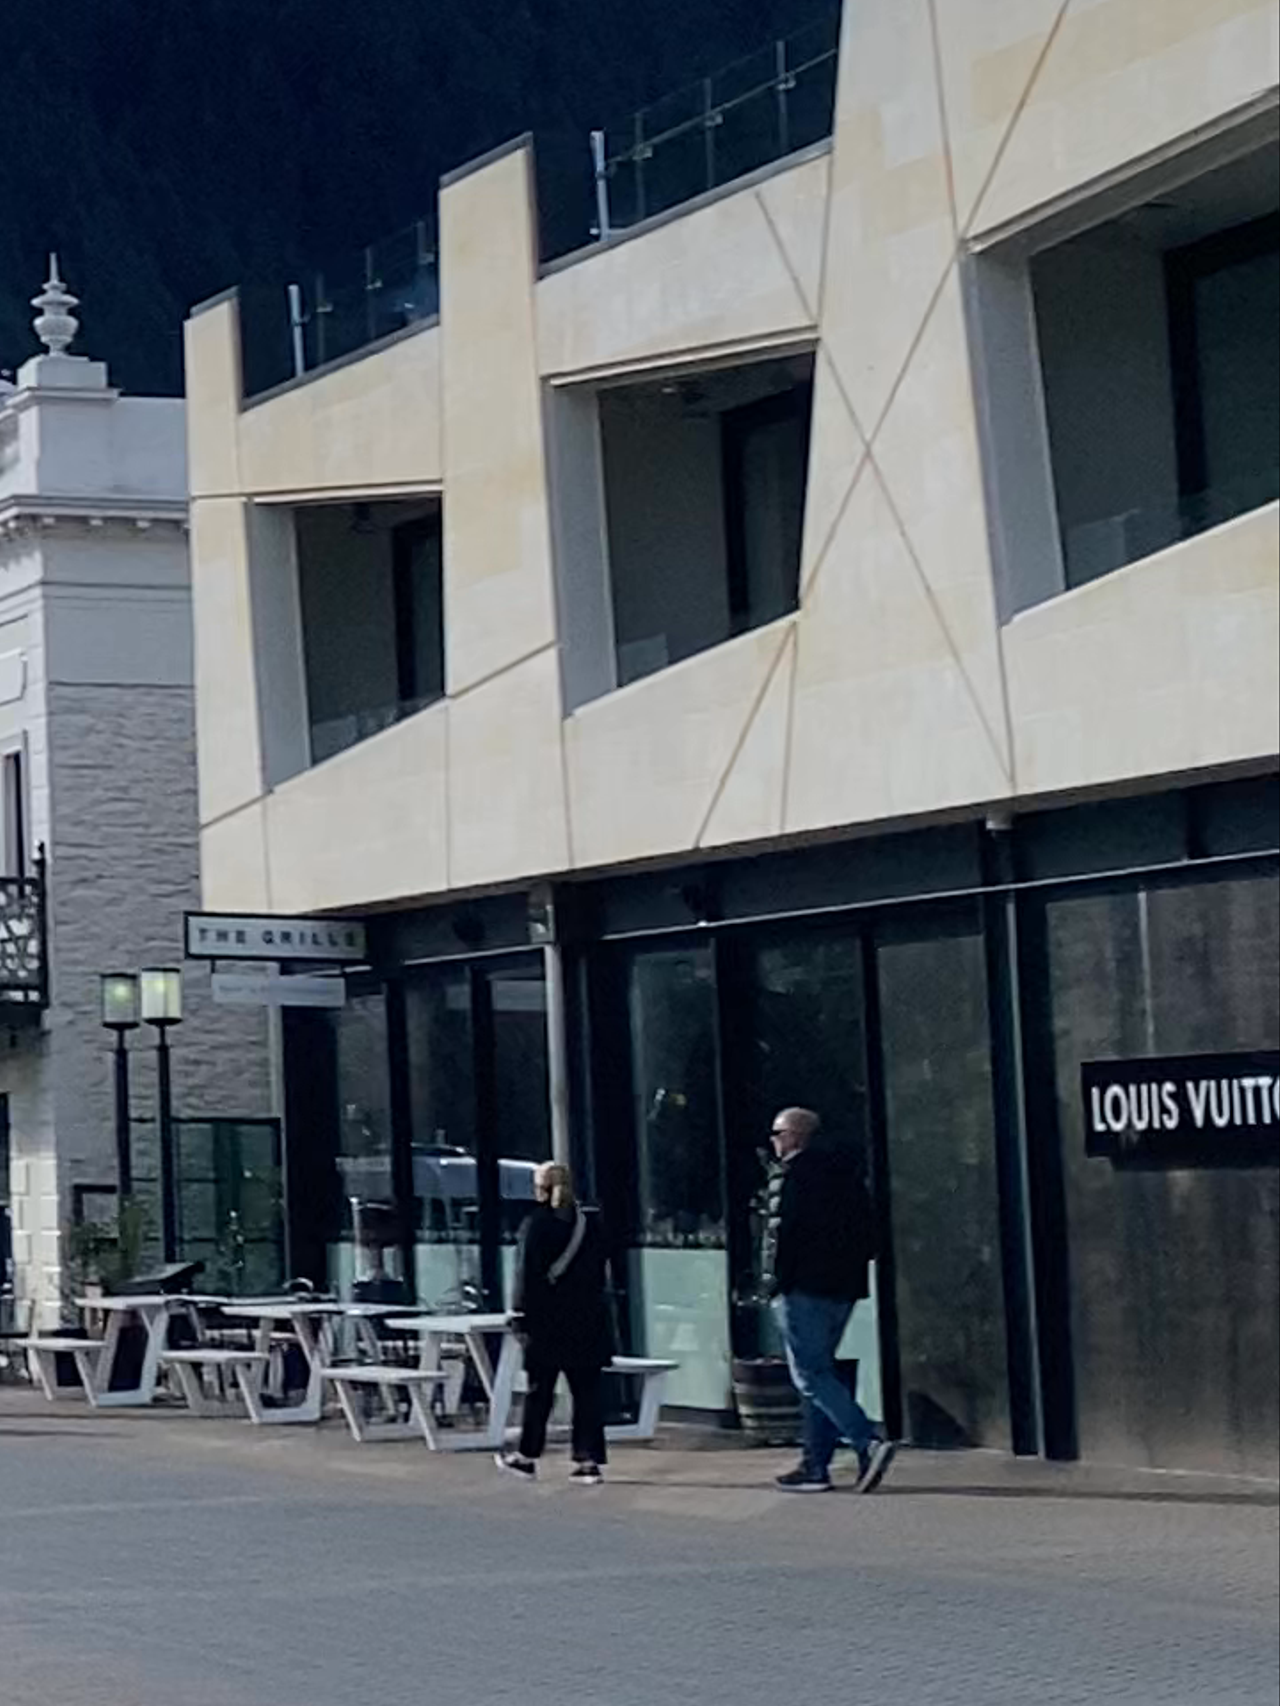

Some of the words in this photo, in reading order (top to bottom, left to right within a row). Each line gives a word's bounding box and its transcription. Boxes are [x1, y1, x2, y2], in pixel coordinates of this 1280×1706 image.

[198, 927, 246, 944] THE
[262, 930, 358, 947] GRILLE
[1091, 1080, 1180, 1132] LOUIS
[1185, 1075, 1280, 1129] VUITT
